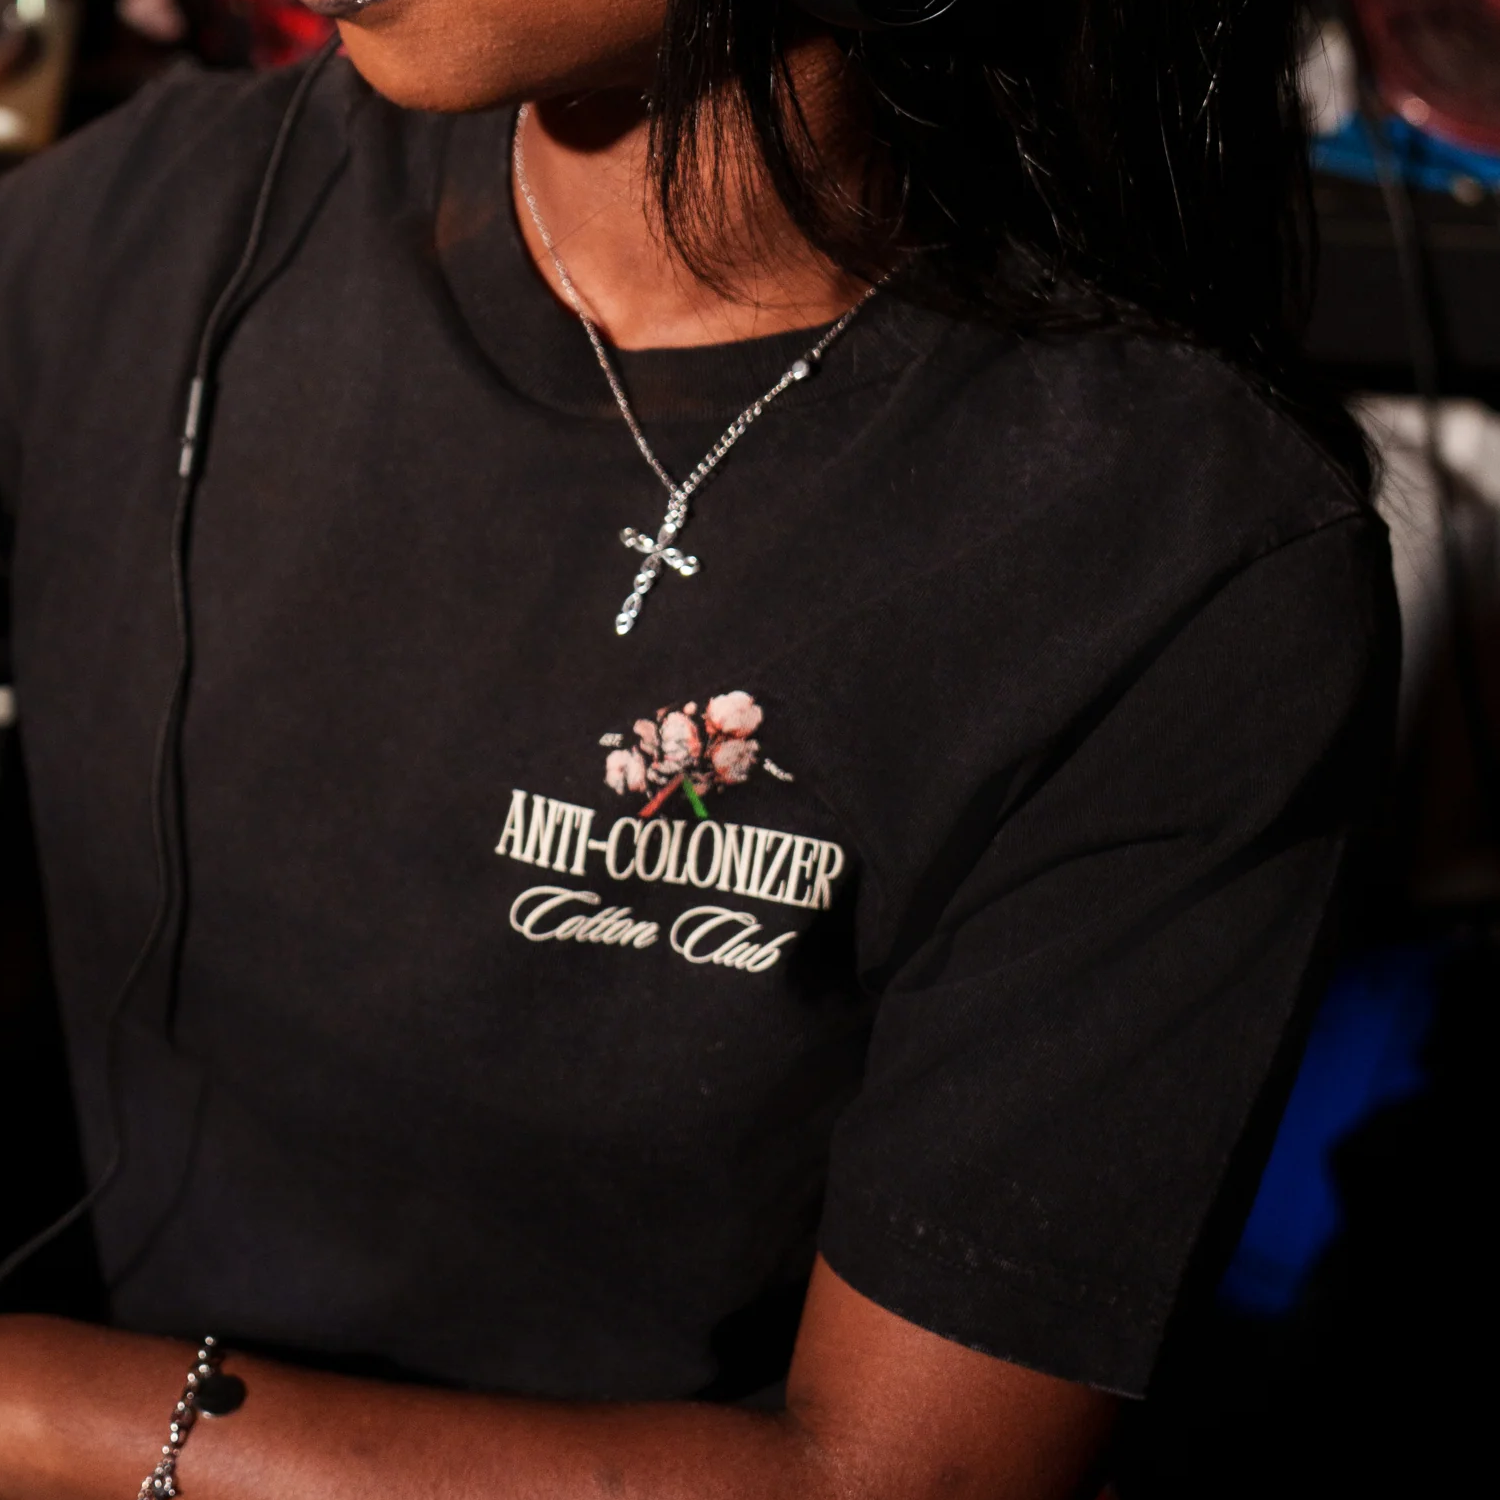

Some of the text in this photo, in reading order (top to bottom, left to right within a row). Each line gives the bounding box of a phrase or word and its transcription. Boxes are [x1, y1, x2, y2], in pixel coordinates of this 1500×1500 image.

[494, 788, 846, 912] ANTI-COLONIZER
[509, 885, 799, 974] Cotton Club
